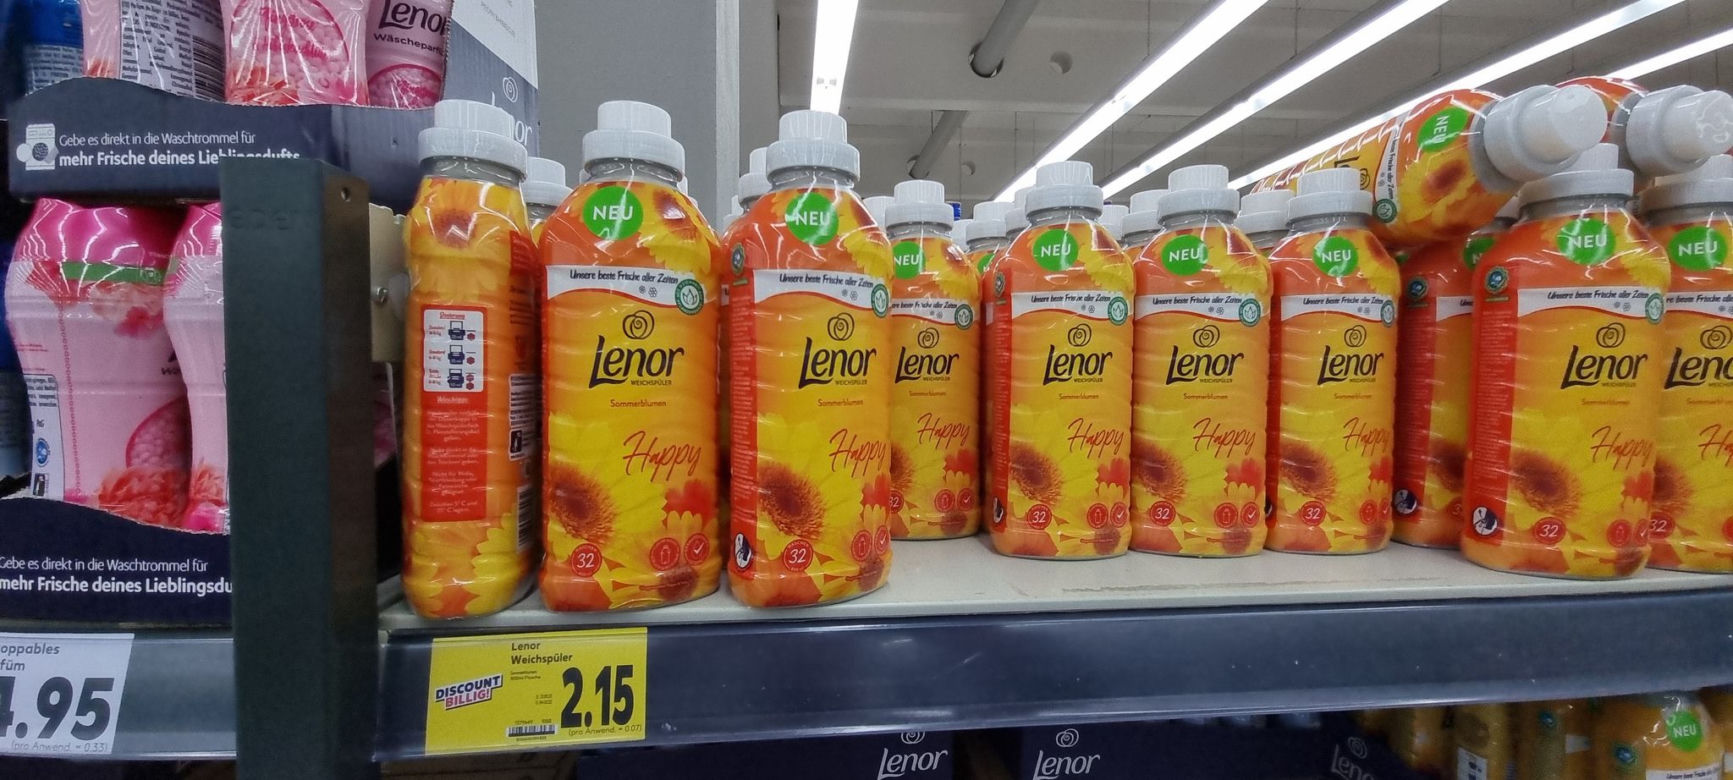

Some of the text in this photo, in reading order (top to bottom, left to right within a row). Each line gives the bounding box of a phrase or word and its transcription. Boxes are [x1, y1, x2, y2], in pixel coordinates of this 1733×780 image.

[59, 130, 256, 146] Gebe es direkt in die Waschtrommel für
[59, 151, 94, 166] mehr
[97, 150, 146, 166] Frische
[149, 149, 195, 165] deines
[592, 205, 634, 221] NEU
[795, 211, 831, 226] NEU
[1571, 235, 1607, 248] NEU
[1678, 240, 1718, 257] NEU
[1040, 244, 1071, 257] NEU
[1169, 249, 1201, 262] NEU
[1321, 249, 1351, 263] NEU
[895, 254, 920, 266] NEU
[570, 269, 679, 284] Unsere beste Frische aller Zeiten
[779, 273, 803, 283] Unsere
[805, 274, 821, 283] beste
[822, 274, 844, 285] Frische
[845, 276, 857, 286] aller
[1189, 296, 1211, 304] Frische
[589, 335, 685, 389] Lenor
[798, 337, 877, 389] Lenor
[895, 346, 960, 384] Lenor
[1043, 344, 1113, 385] Lenor
[1166, 345, 1244, 385] Lenor
[1317, 345, 1385, 386] Lenor
[1560, 345, 1648, 389] Lenor
[630, 378, 672, 386] WEICHSPÜLER
[610, 399, 667, 408] Sommerblumen
[817, 399, 864, 407] Sommerblumen
[917, 412, 970, 449] Happy
[1067, 418, 1124, 459] Happy
[1193, 417, 1256, 458] Happy
[1343, 416, 1390, 457] Happy
[829, 428, 887, 478] Happy
[1590, 425, 1652, 470] Happy
[622, 430, 702, 482] Happy
[1031, 510, 1046, 523] 32
[1154, 507, 1170, 520] 32
[1305, 507, 1321, 520] 32
[1539, 523, 1559, 537] 32
[1651, 519, 1667, 533] 32
[577, 552, 595, 568] 32
[789, 548, 806, 563] 32
[0, 557, 208, 572] Gebe es direkt in die Waschtrommel für
[0, 575, 34, 591] mehr
[37, 576, 89, 593] Frische
[92, 577, 142, 593] deines
[511, 642, 541, 651] Lenor
[511, 653, 573, 665] Weichspüler
[435, 675, 501, 699] DISCOUNT
[445, 688, 491, 708] BILLIG!
[561, 665, 634, 729] 2.15
[1673, 724, 1696, 738] NEU
[877, 748, 948, 780] Lenor
[1032, 750, 1100, 780] Lenor
